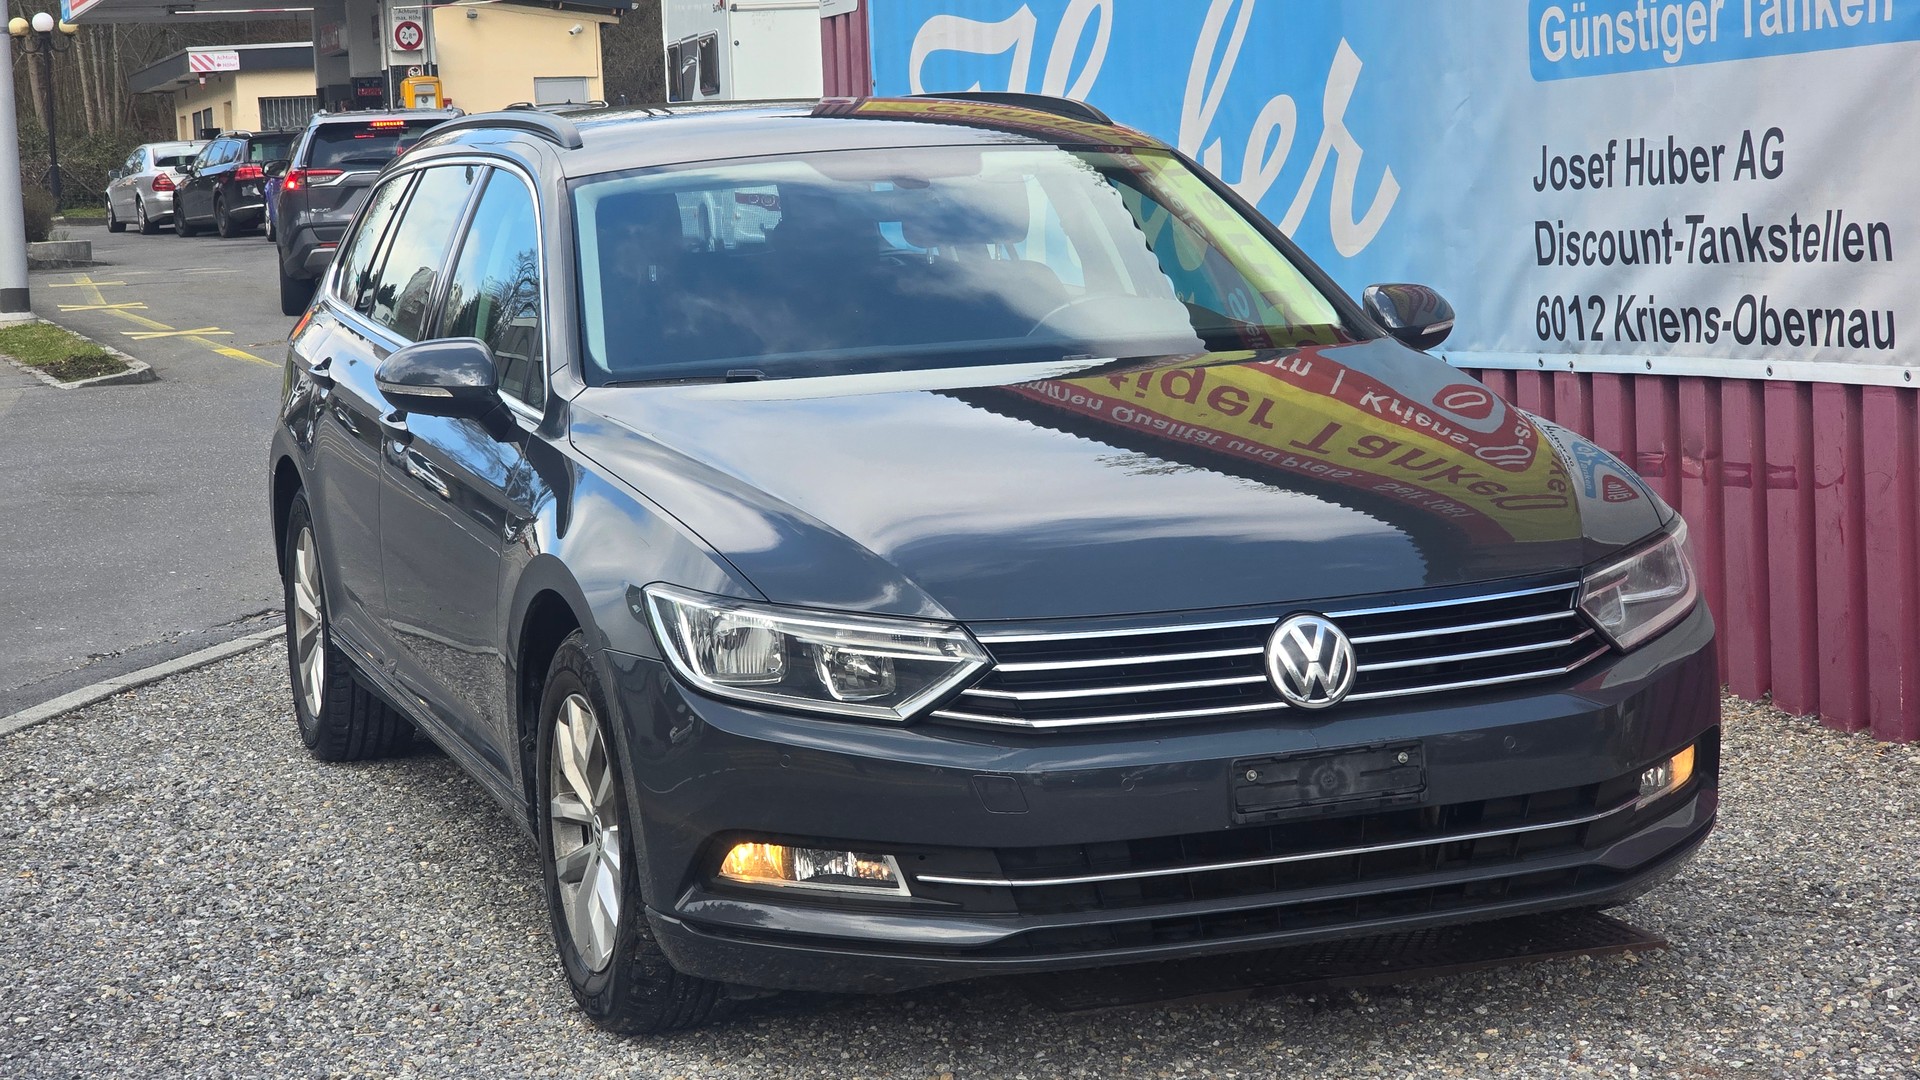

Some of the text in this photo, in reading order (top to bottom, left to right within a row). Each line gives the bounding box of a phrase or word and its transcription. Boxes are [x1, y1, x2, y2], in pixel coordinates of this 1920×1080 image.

[1539, 0, 1723, 64] Günstiger
[1533, 127, 1784, 192] Josef Huber AG
[1534, 209, 1893, 266] Discount-Tankstellen
[1535, 294, 1895, 349] 6012 Kriens-Obernau
